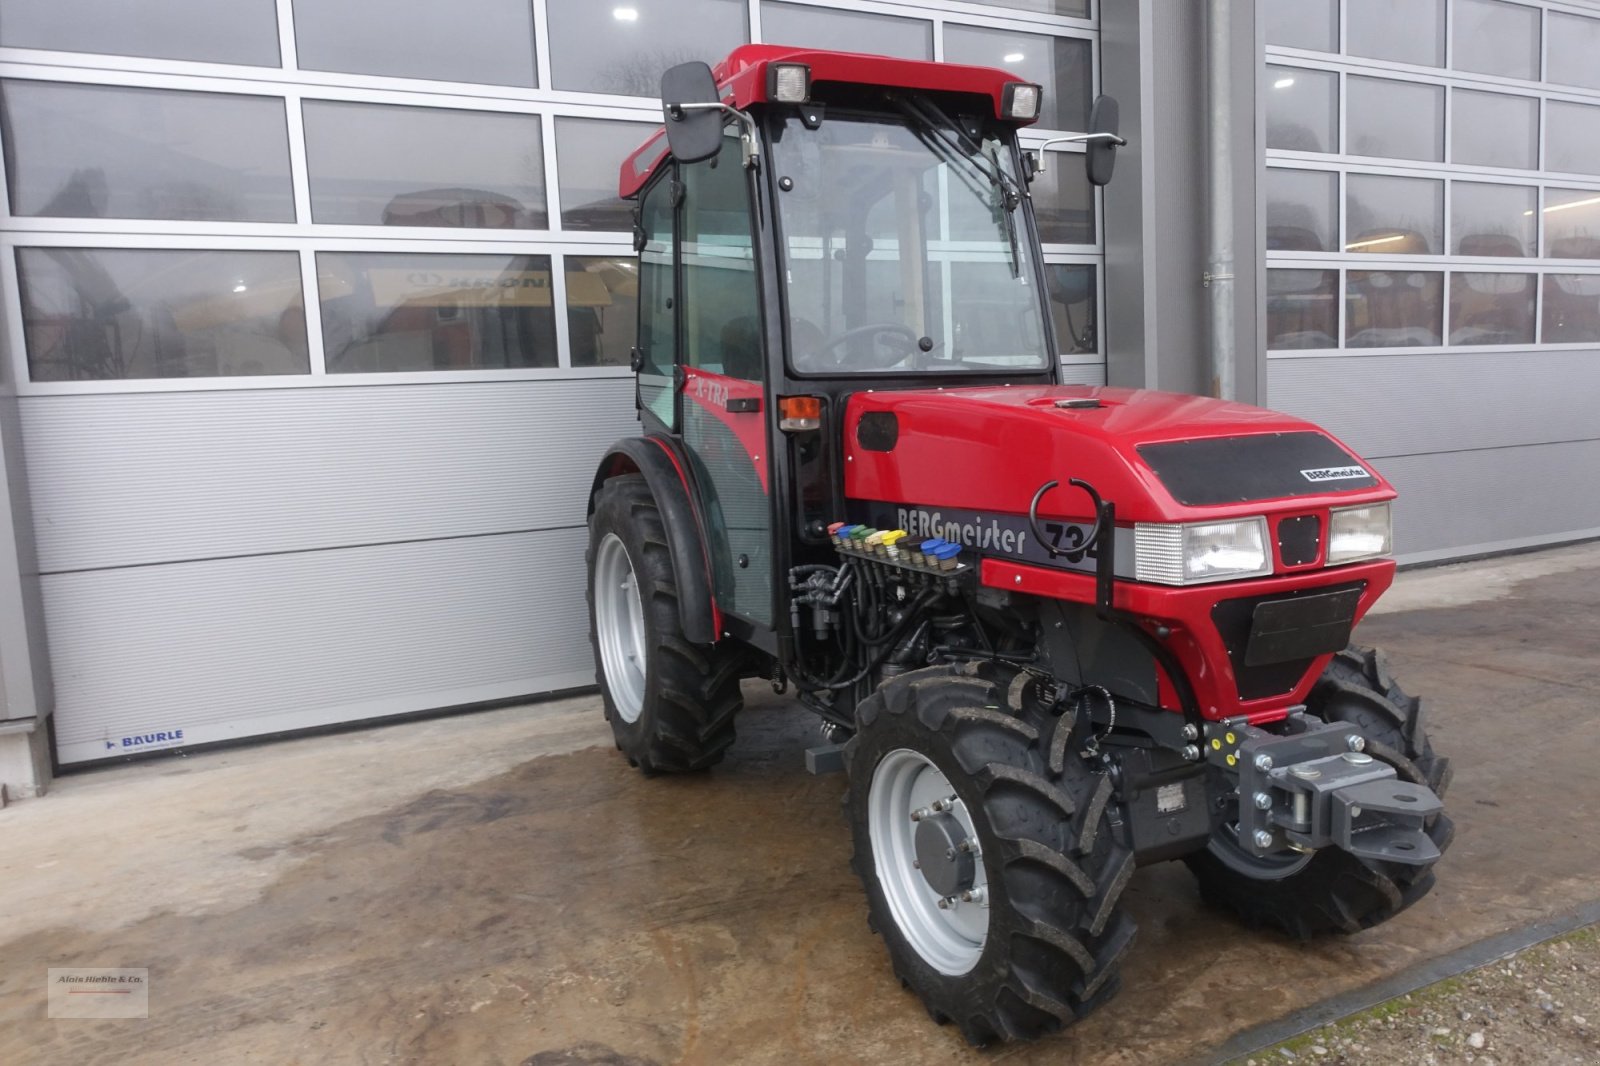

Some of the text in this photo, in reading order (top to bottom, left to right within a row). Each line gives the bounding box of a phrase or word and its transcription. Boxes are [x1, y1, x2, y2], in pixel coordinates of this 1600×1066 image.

[448, 277, 550, 288] KRON
[695, 377, 729, 408] X-TRA
[1305, 469, 1366, 480] BERGmeister
[897, 508, 1026, 554] BERGmeister
